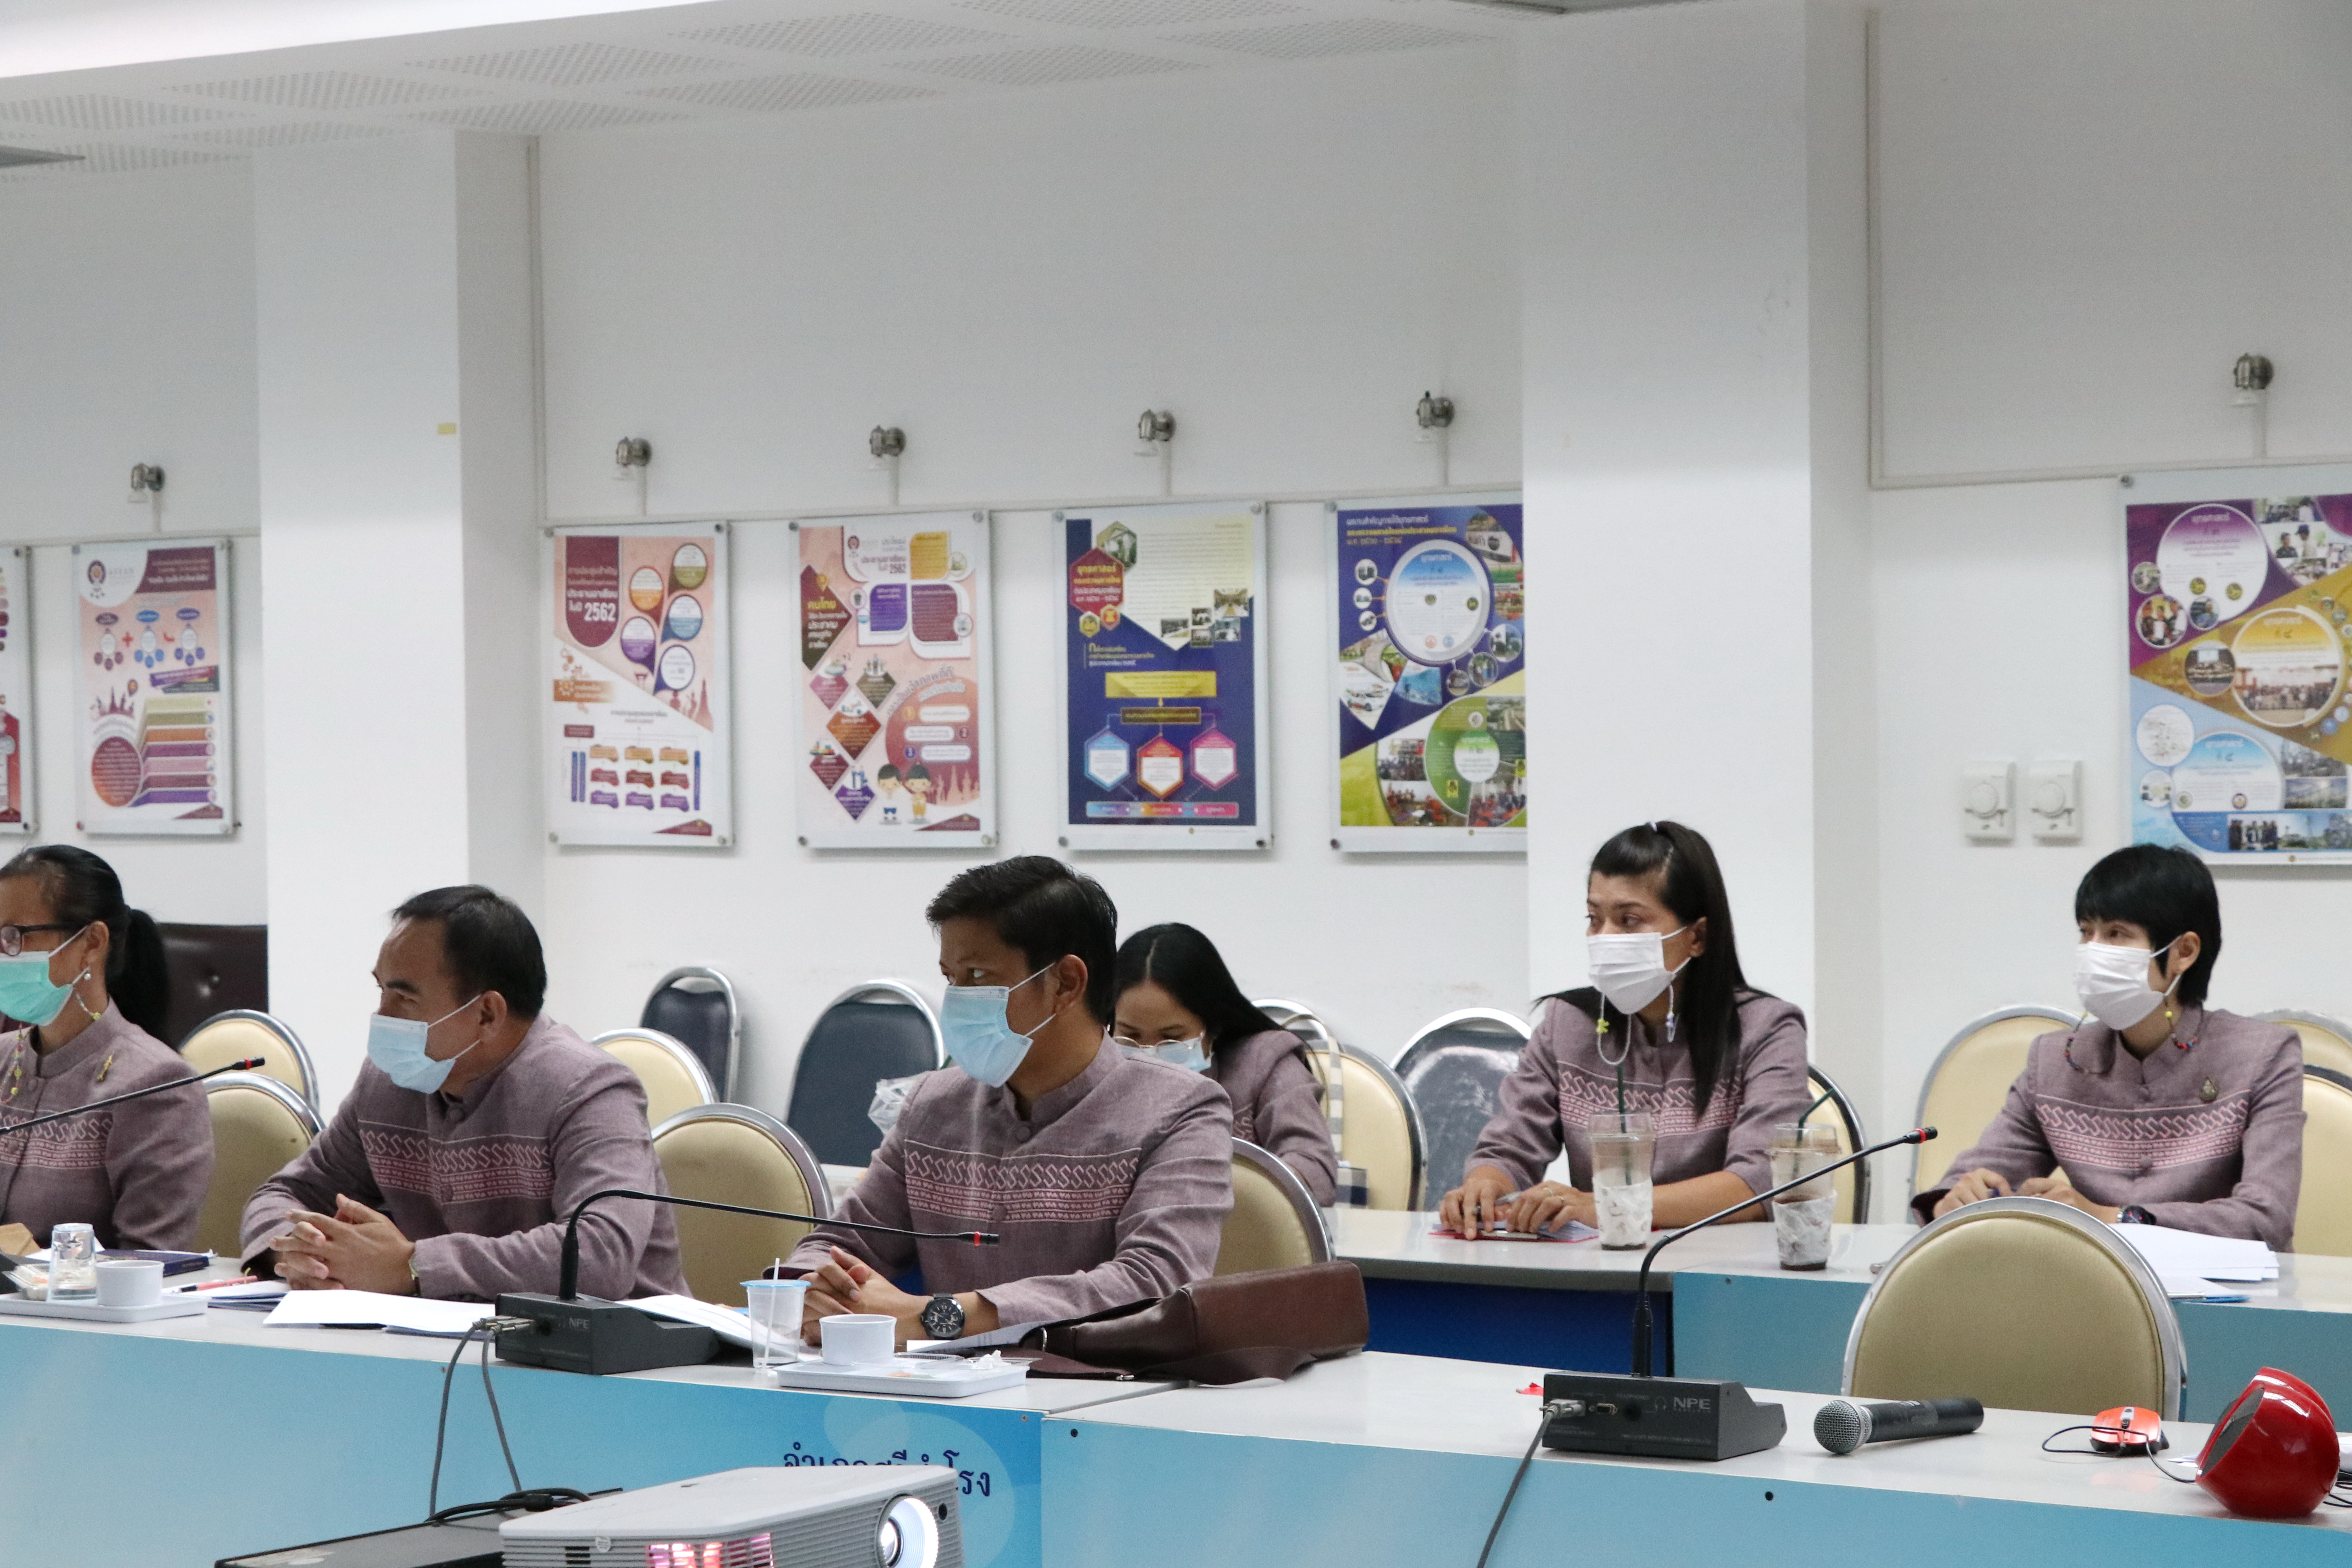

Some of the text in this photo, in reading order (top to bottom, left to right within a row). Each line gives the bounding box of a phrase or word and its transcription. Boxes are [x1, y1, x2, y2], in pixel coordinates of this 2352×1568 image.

[584, 602, 616, 621] 2562
[569, 1317, 590, 1329] NPE
[1673, 1397, 1711, 1409] NPE
